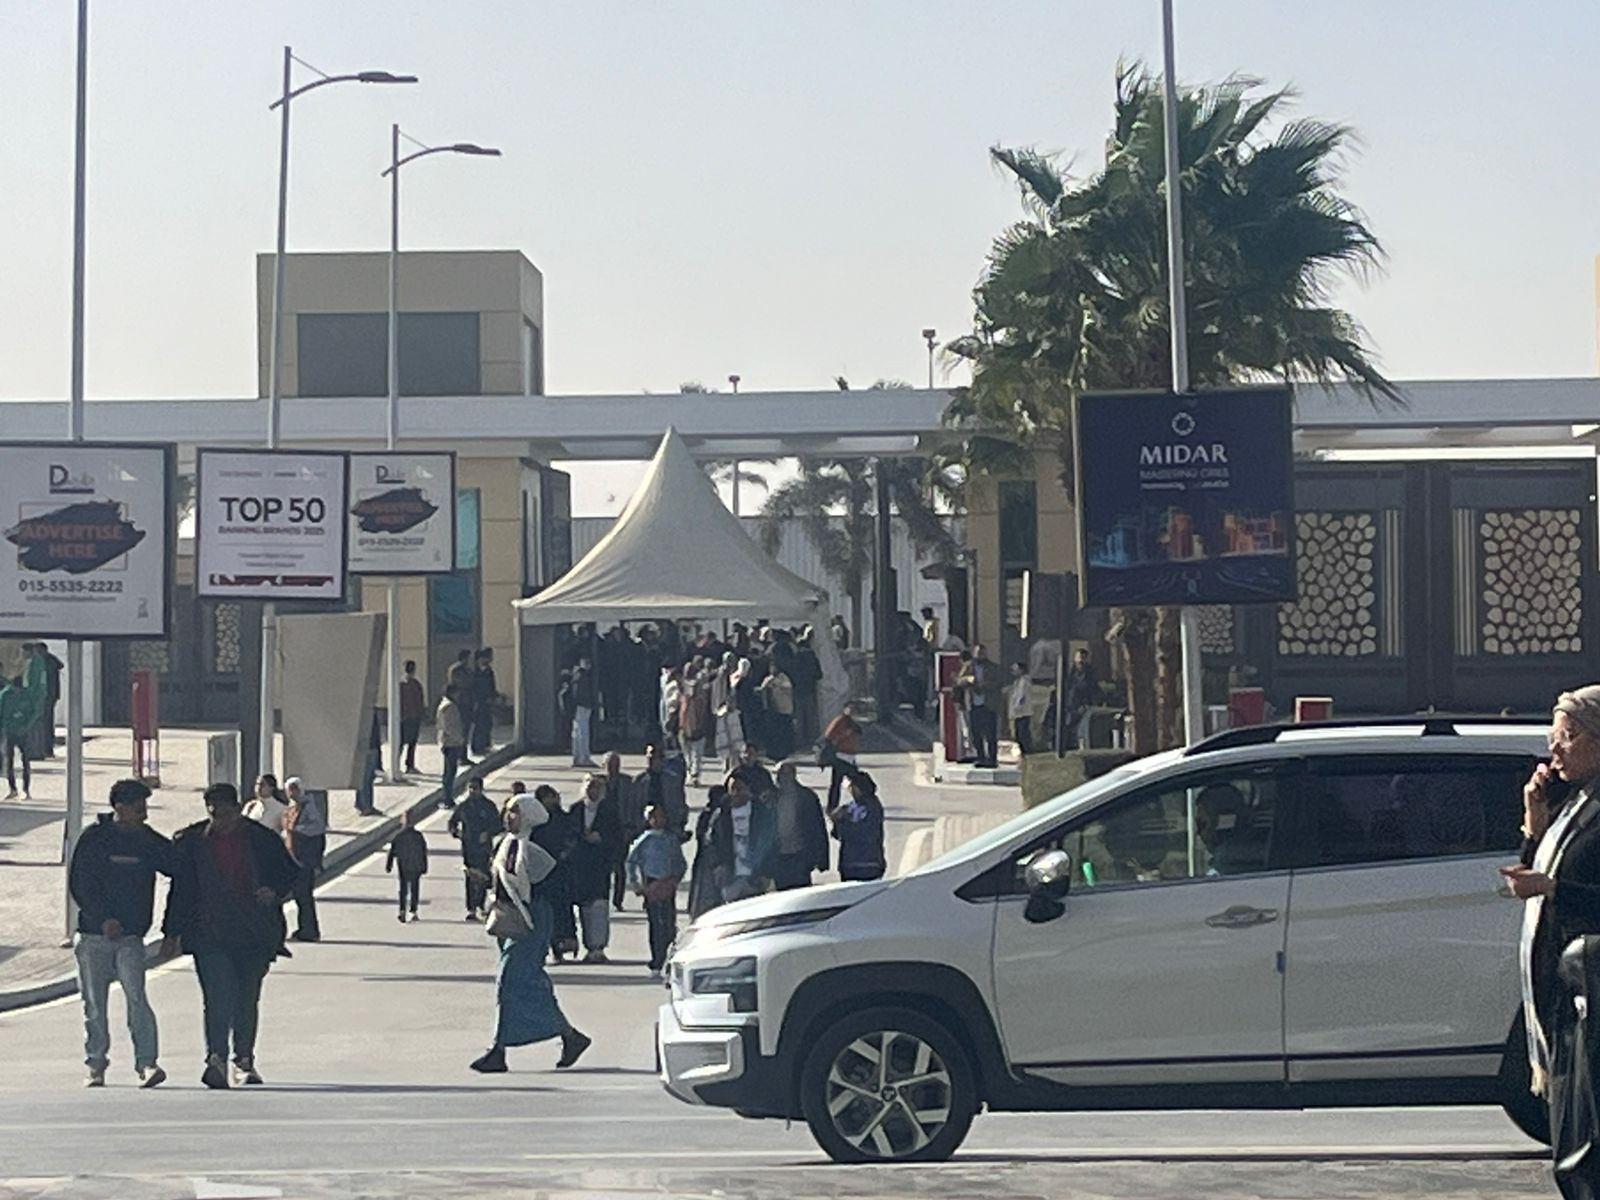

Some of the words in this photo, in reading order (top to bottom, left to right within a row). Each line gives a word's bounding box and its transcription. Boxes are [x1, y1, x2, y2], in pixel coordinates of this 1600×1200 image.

[1140, 444, 1228, 464] MIDAR
[219, 497, 283, 522] TOP
[288, 497, 325, 523] 50
[21, 523, 124, 540] ADVERTISE
[48, 542, 97, 558] HERE
